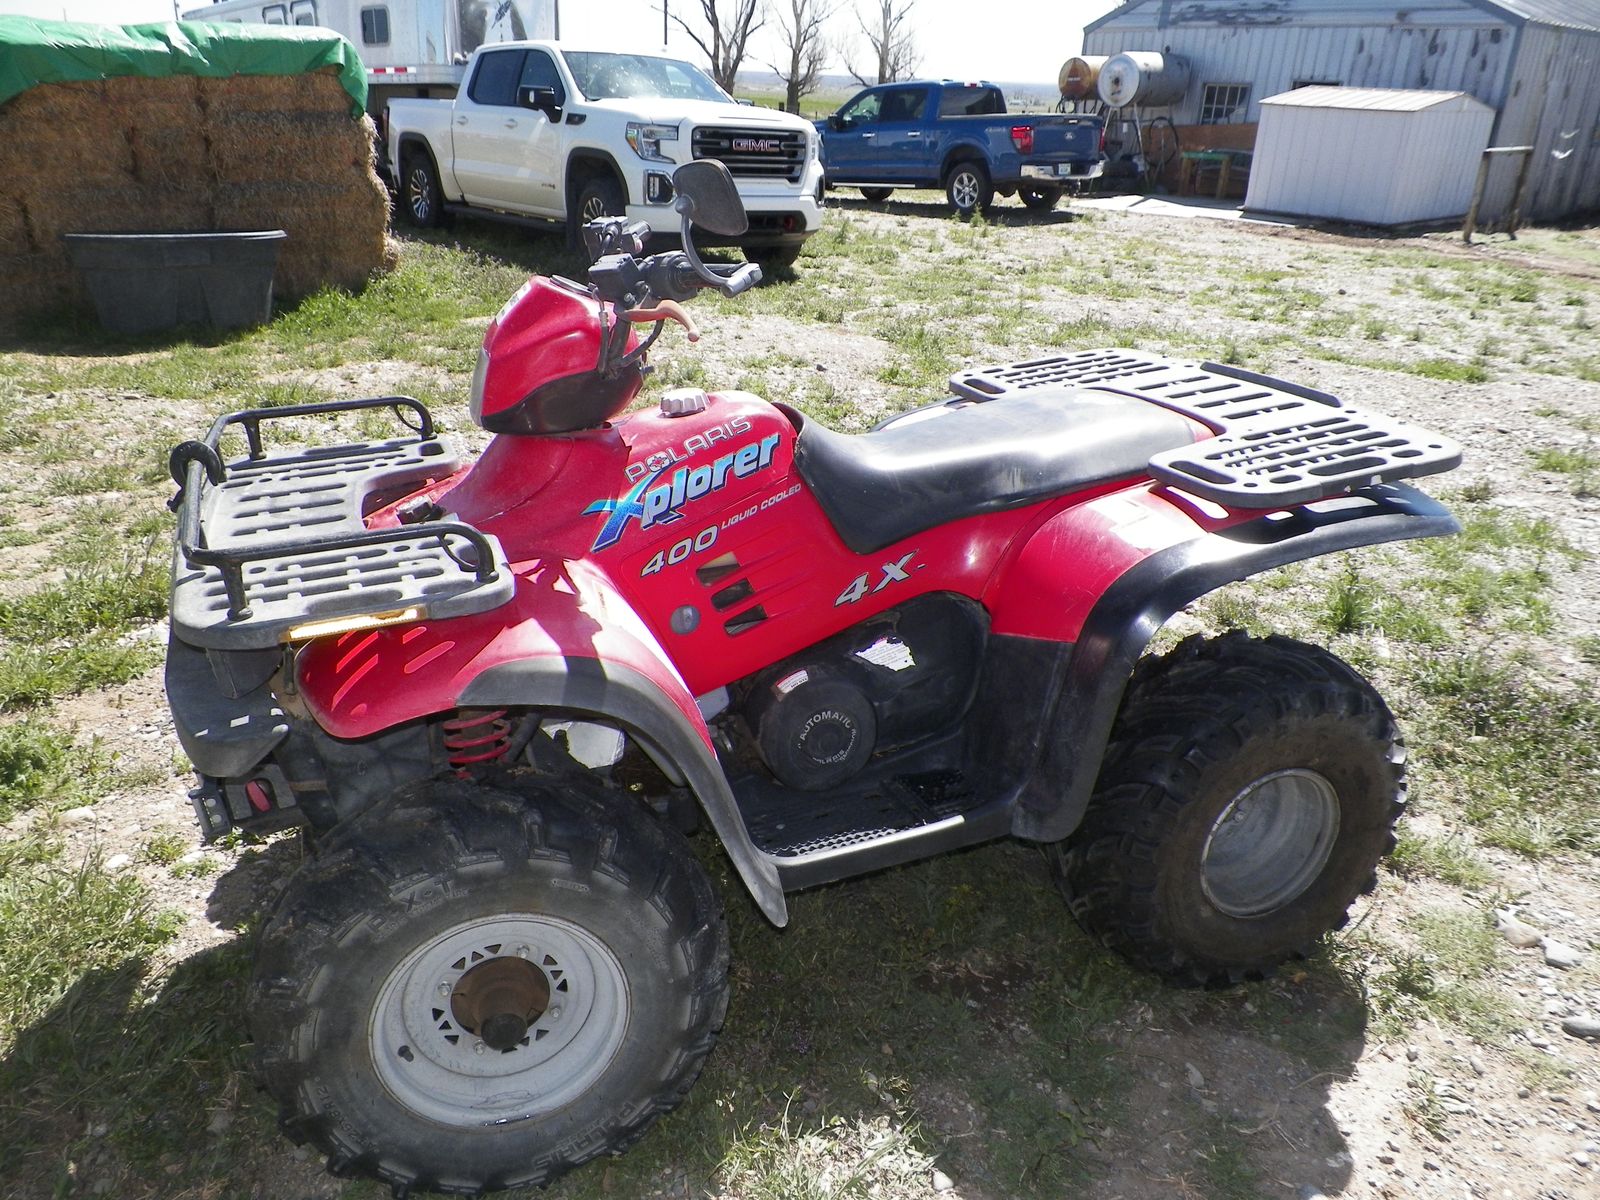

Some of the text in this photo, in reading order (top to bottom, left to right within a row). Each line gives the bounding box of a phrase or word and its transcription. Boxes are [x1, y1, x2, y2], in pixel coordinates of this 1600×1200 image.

[732, 138, 781, 152] GMC
[624, 415, 753, 483] POLARIS
[580, 432, 781, 553] Xplorer
[640, 482, 802, 578] 400 LIQUID COOLED
